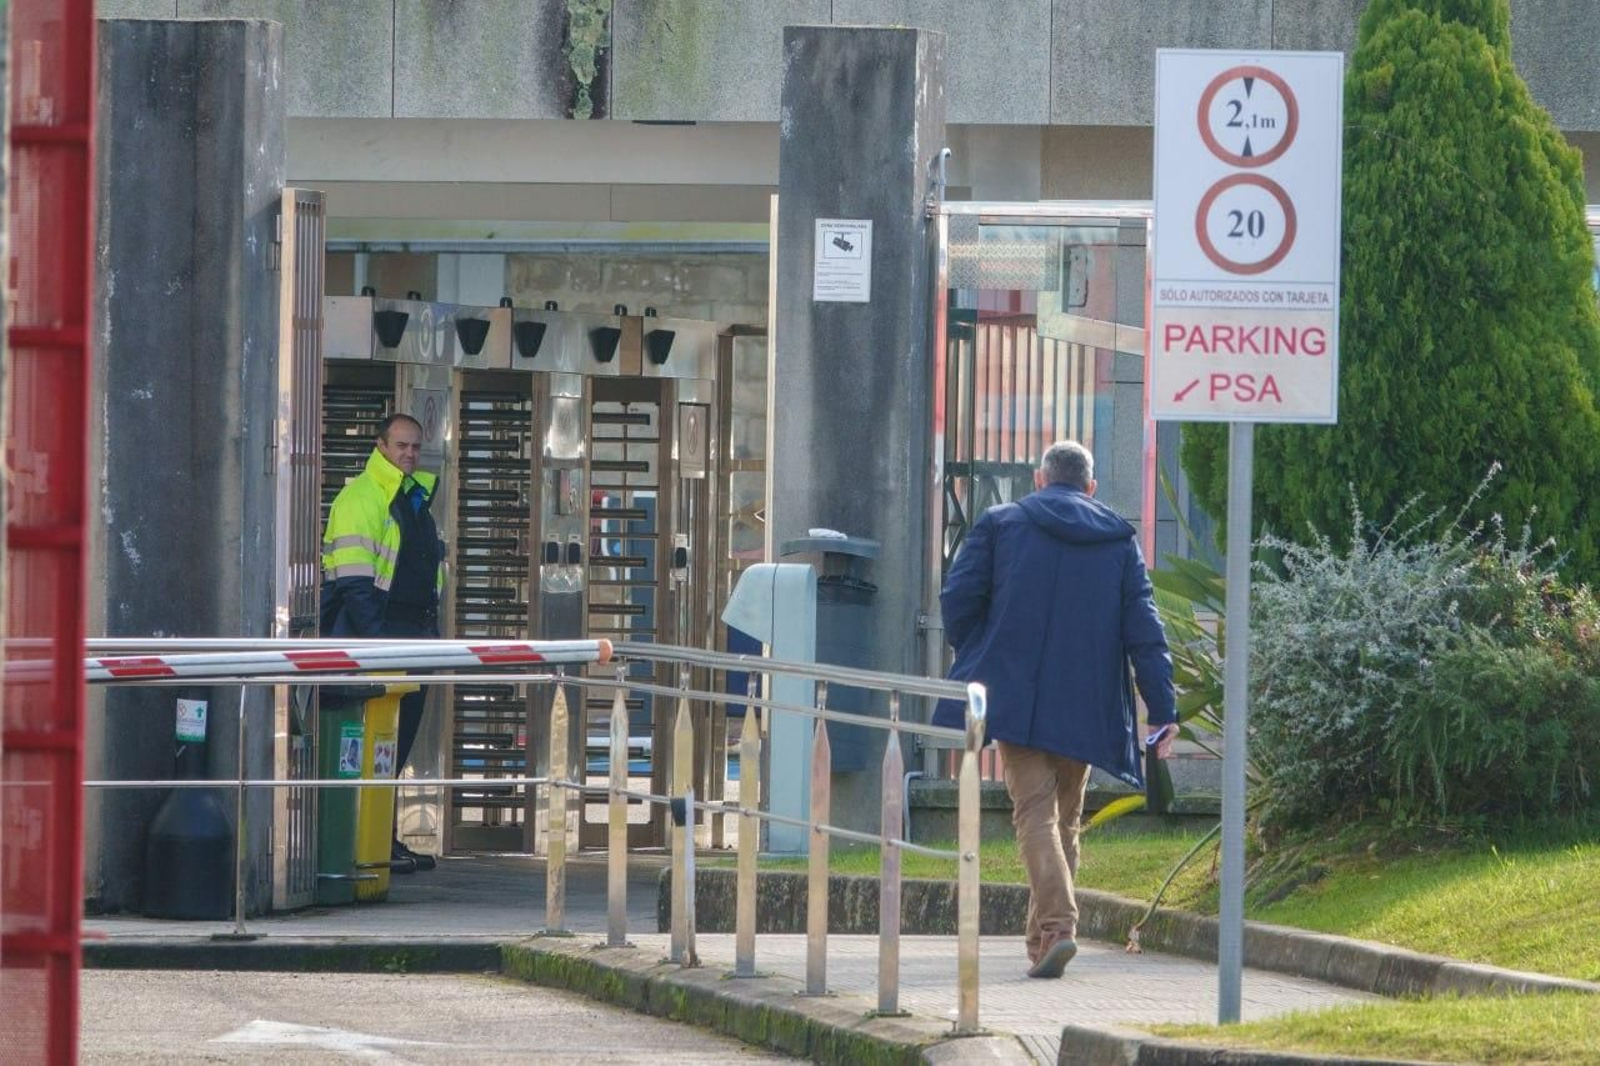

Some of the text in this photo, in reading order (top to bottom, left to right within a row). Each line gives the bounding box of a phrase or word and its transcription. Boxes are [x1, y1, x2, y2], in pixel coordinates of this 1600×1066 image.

[1227, 209, 1265, 239] 20
[1160, 287, 1329, 304] SÓLO AUTORIZADOS CON TARJETA
[1165, 324, 1326, 356] PARKING
[1209, 374, 1282, 402] PSA
